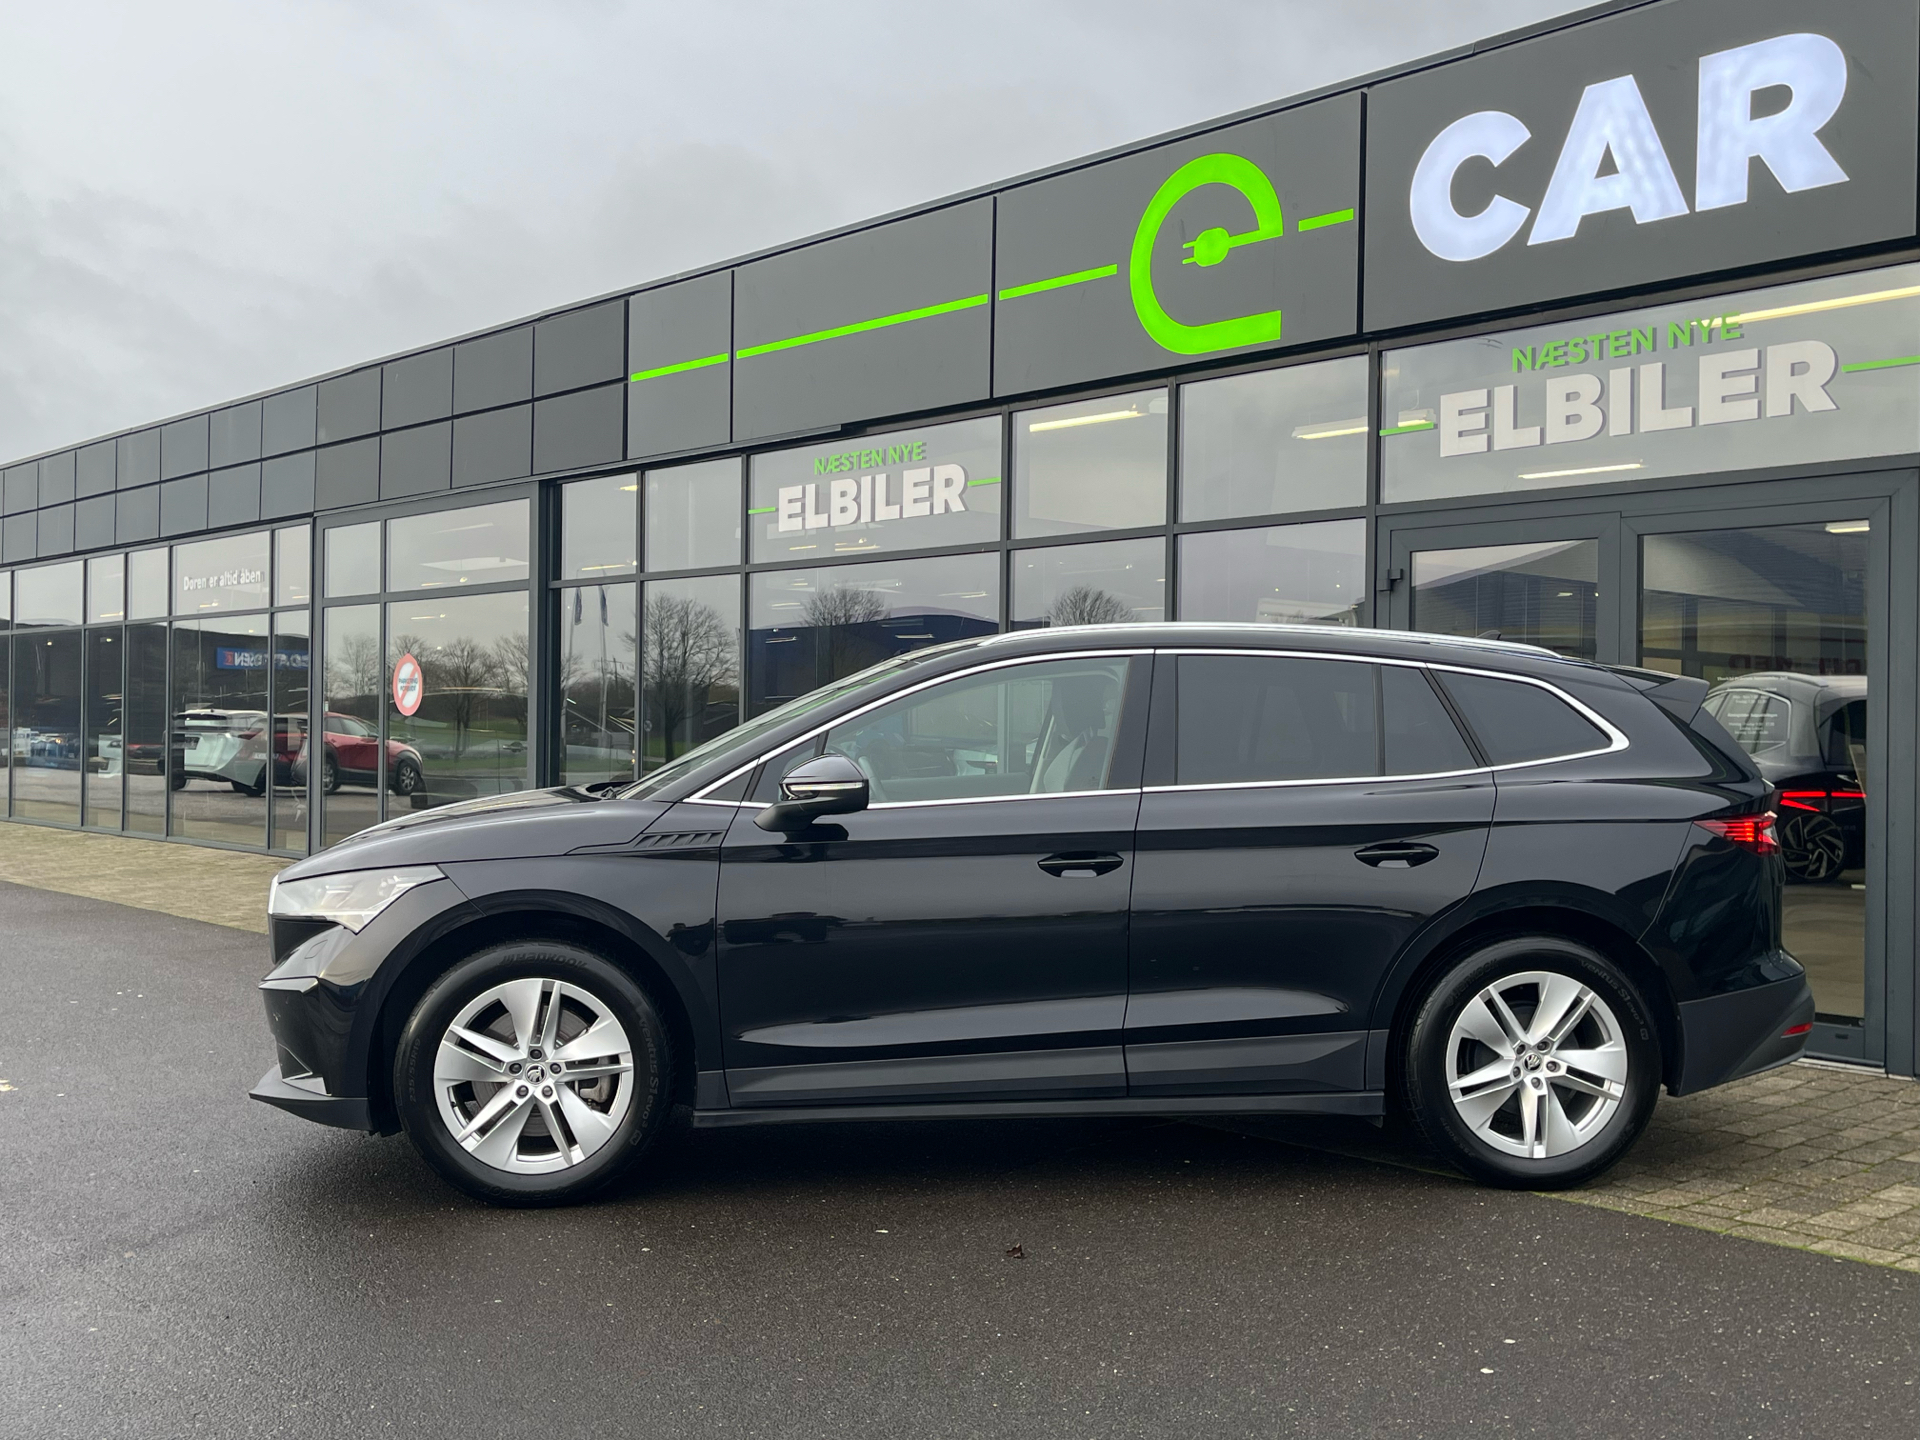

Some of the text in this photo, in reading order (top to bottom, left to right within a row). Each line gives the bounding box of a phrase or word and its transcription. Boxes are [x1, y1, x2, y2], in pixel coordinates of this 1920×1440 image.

[1410, 33, 1849, 262] CAR
[1512, 311, 1743, 373] NÆSTEN NYE
[1440, 340, 1838, 458] ELBILER
[814, 442, 924, 475] NÆSTEN NYE
[779, 464, 967, 532] ELBILER
[209, 575, 218, 588] er
[219, 570, 238, 586] altid
[240, 568, 261, 584] åben
